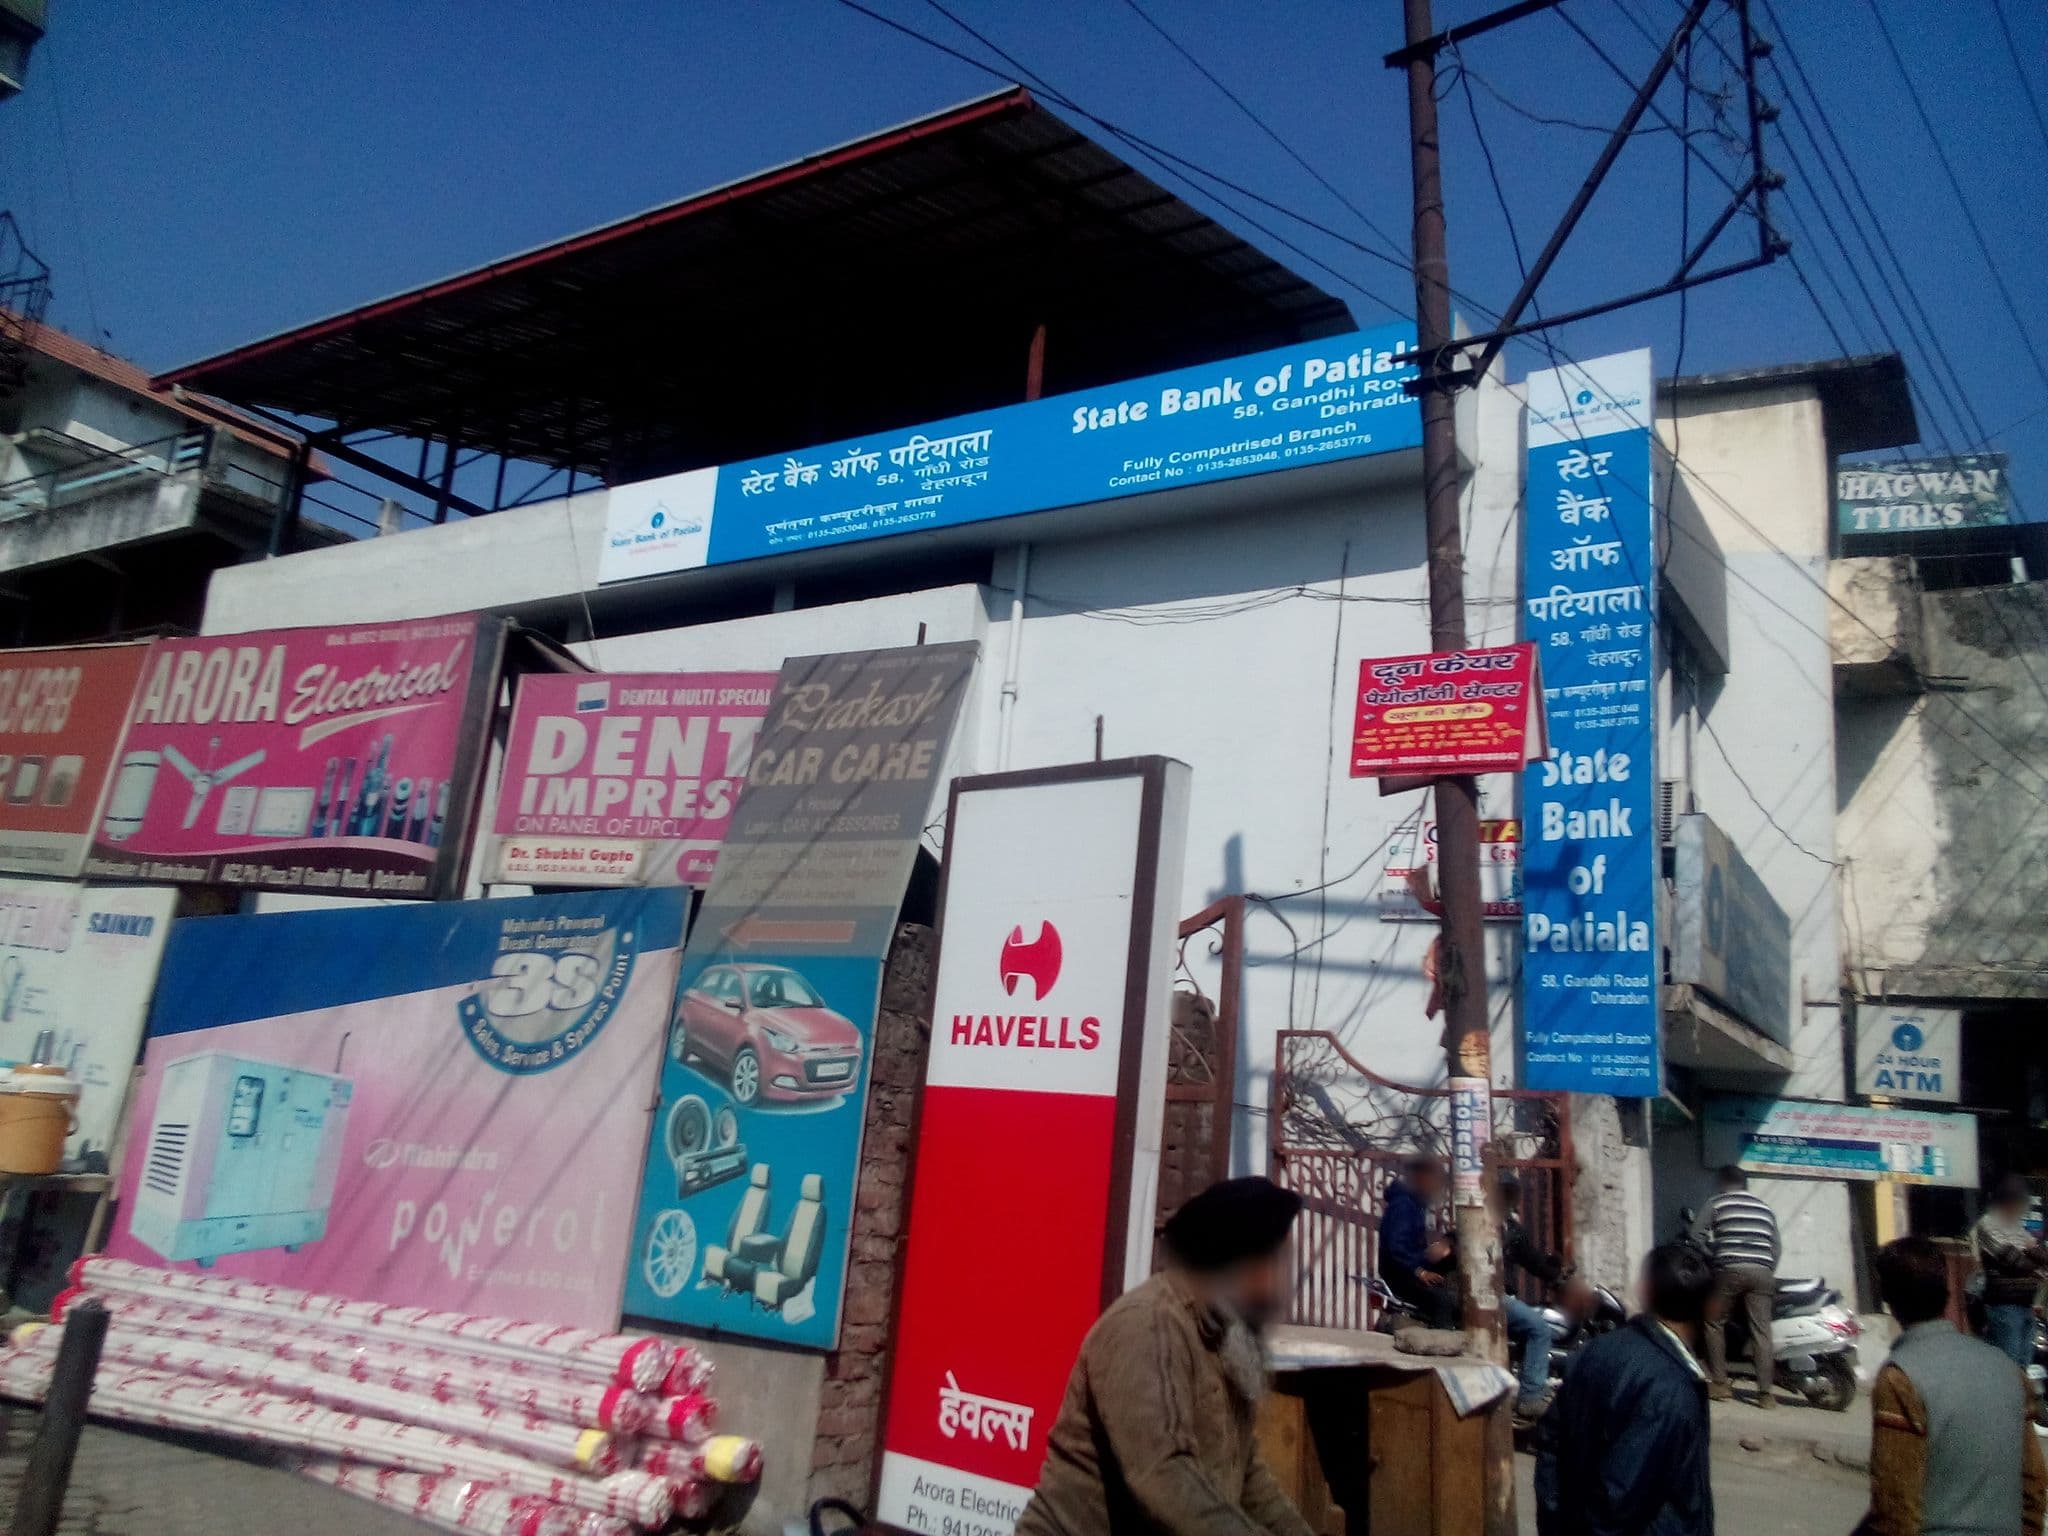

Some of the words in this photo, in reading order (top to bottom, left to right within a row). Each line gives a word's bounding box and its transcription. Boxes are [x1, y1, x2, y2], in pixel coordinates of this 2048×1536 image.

[1073, 398, 1149, 434] State
[1160, 377, 1244, 417] Bank
[1254, 363, 1293, 397] of
[1272, 383, 1355, 412] Gandhi
[1319, 392, 1419, 419] Dehradu
[740, 469, 780, 496] स्टेट
[783, 457, 823, 489] बैंक
[829, 447, 882, 479] ऑफ
[888, 428, 993, 468] पटियाला
[1122, 456, 1163, 473] Fully
[1168, 433, 1284, 465] Computrised
[1288, 420, 1358, 444] Branch
[920, 470, 989, 491] देहरादून
[1108, 470, 1162, 488] Contact
[1164, 466, 1184, 478] No
[1556, 448, 1613, 482] स्टेट
[1556, 489, 1612, 527] बैंक
[1852, 502, 1965, 530] TYRES
[1550, 534, 1623, 572] ऑफ
[1527, 584, 1645, 622] पटियाला
[134, 644, 287, 725] ARORA
[283, 638, 466, 725] Electrical
[1373, 659, 1426, 687] दून
[1431, 651, 1519, 674] केयर
[618, 688, 669, 706] DENTAL
[672, 688, 716, 706] MULTI
[774, 671, 946, 734] Prakash
[526, 715, 766, 778] DENT
[749, 746, 825, 787] CAR
[830, 739, 938, 785] CARE
[1541, 747, 1632, 787] State
[519, 776, 743, 821] IMPRES
[515, 815, 549, 833] ON
[551, 816, 601, 835] PANEL
[606, 817, 632, 836] OF
[638, 818, 682, 837] UPCL
[1541, 797, 1634, 841] Bank
[510, 846, 530, 860] Dr.
[534, 846, 585, 861] Shubhi
[589, 848, 635, 864] Gupta
[1568, 853, 1607, 896] of
[557, 914, 605, 931] Powered
[1527, 910, 1650, 953] Patiala
[602, 952, 631, 999] Point
[1562, 973, 1611, 988] Gandhi
[1613, 973, 1650, 988] Road
[1590, 990, 1650, 1006] Dehradun
[951, 1014, 1101, 1051] HAVELLS
[1615, 1032, 1652, 1046] Branch
[1874, 1052, 1894, 1065] 24
[1898, 1055, 1942, 1069] HOUR
[1874, 1068, 1943, 1093] ATM
[912, 1475, 956, 1505] Arora
